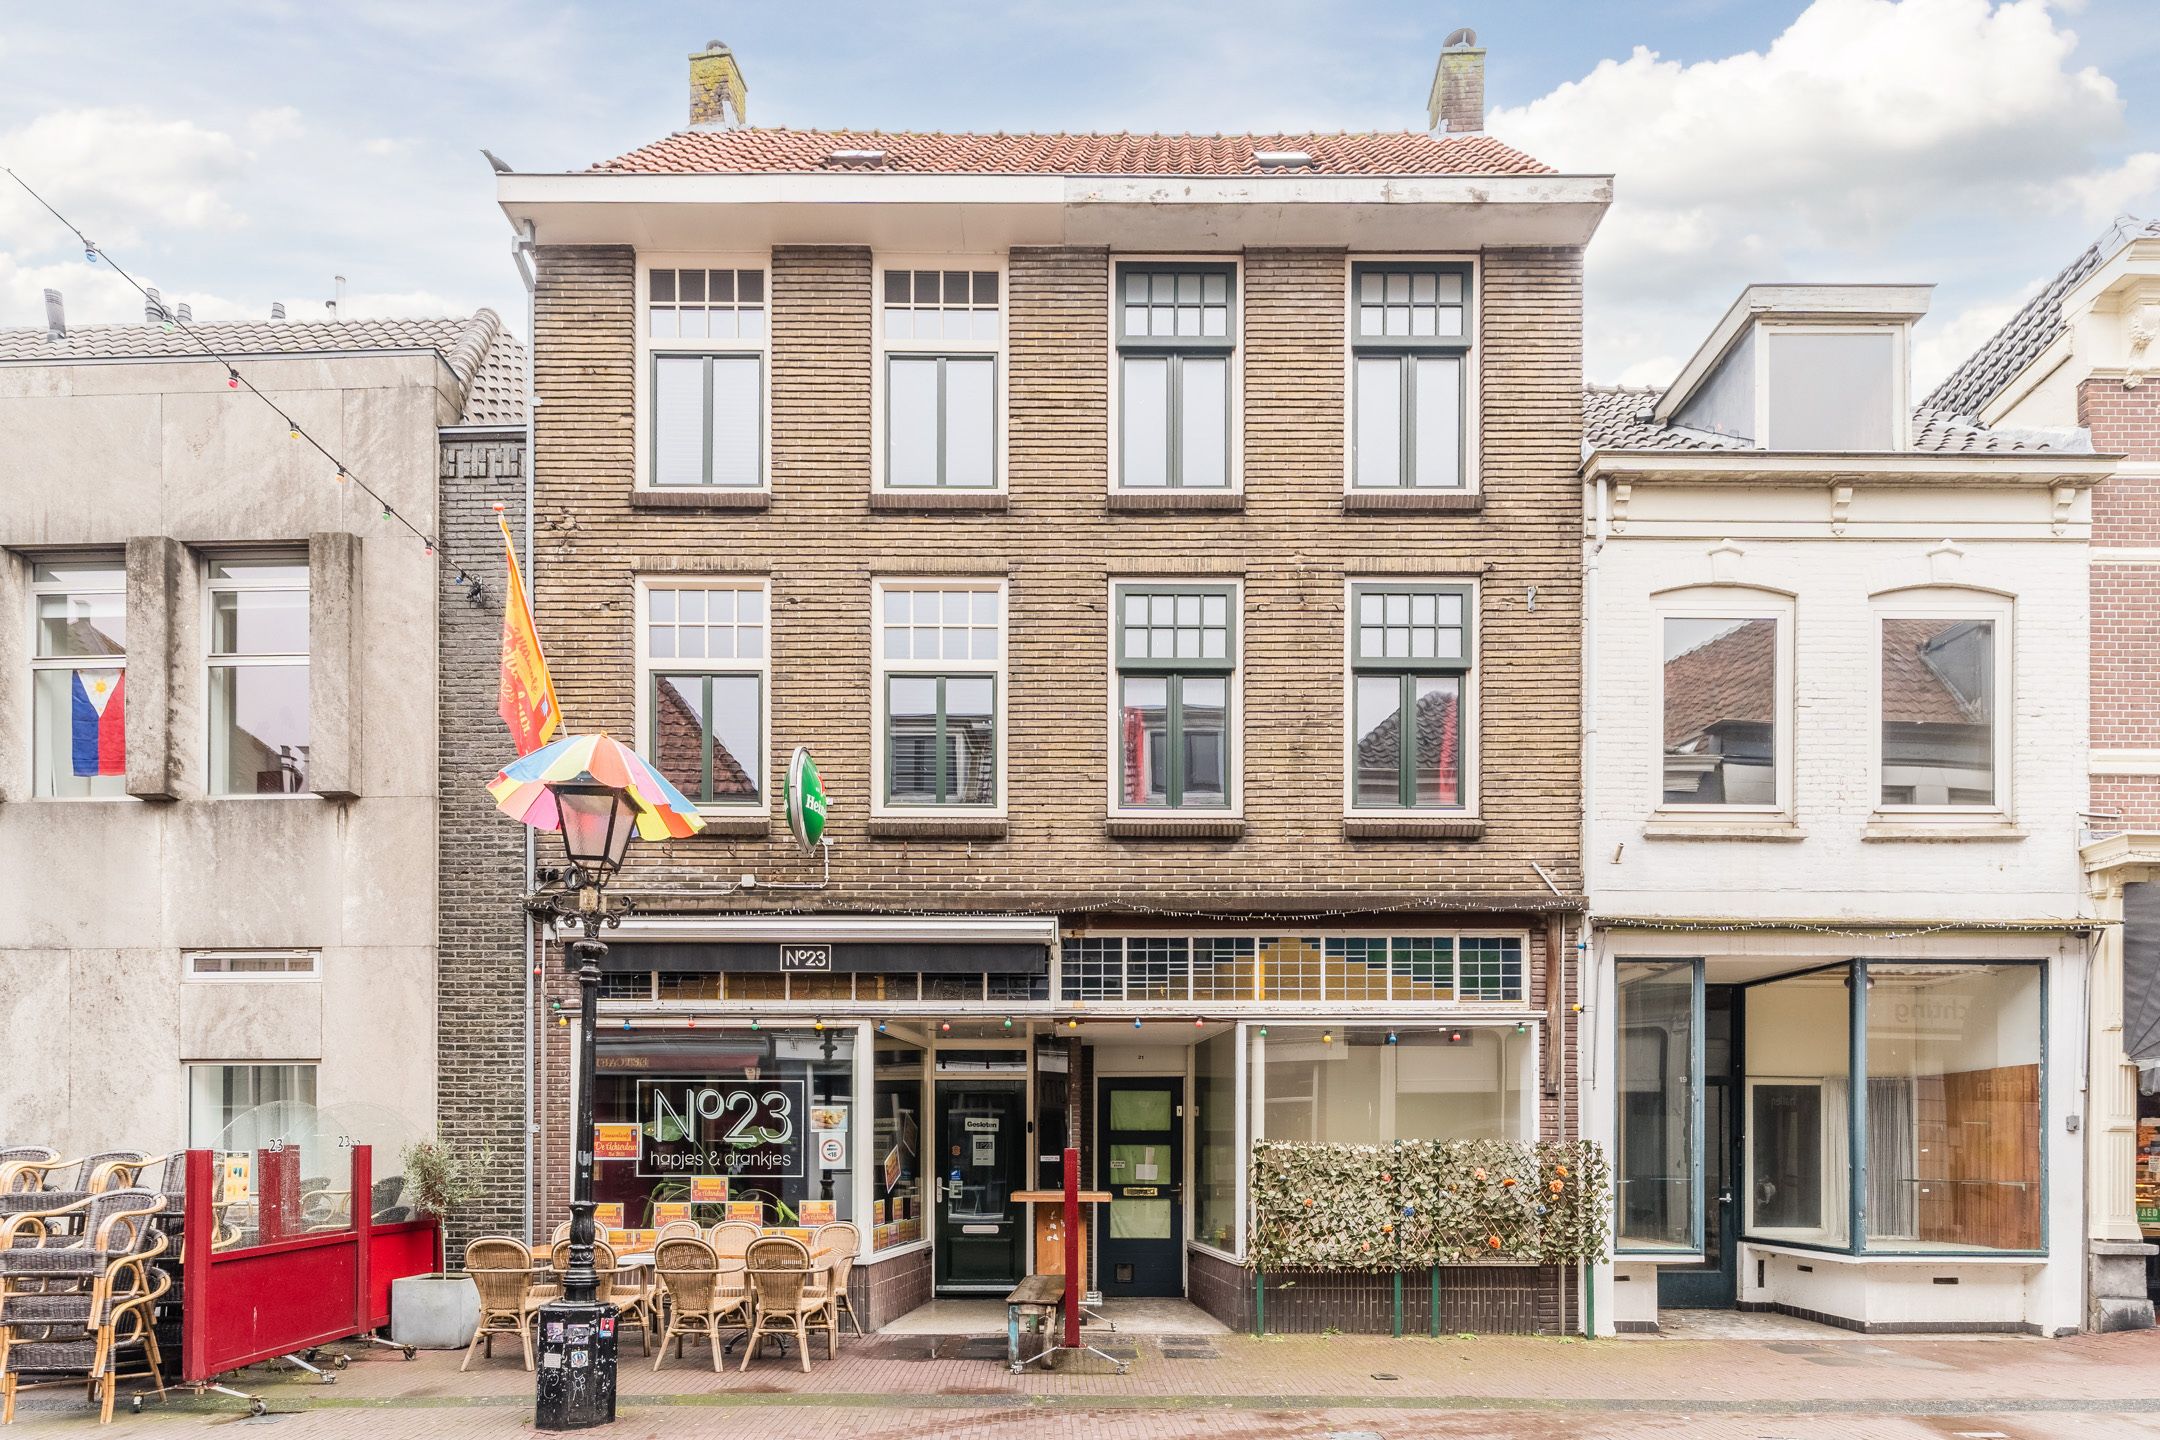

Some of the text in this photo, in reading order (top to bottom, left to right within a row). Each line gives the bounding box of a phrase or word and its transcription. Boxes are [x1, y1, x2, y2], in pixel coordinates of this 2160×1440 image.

[269, 1139, 284, 1152] 23
[339, 1135, 350, 1147] 23
[650, 1151, 792, 1169] hapjes & drankjes
[2141, 1208, 2158, 1217] AED
